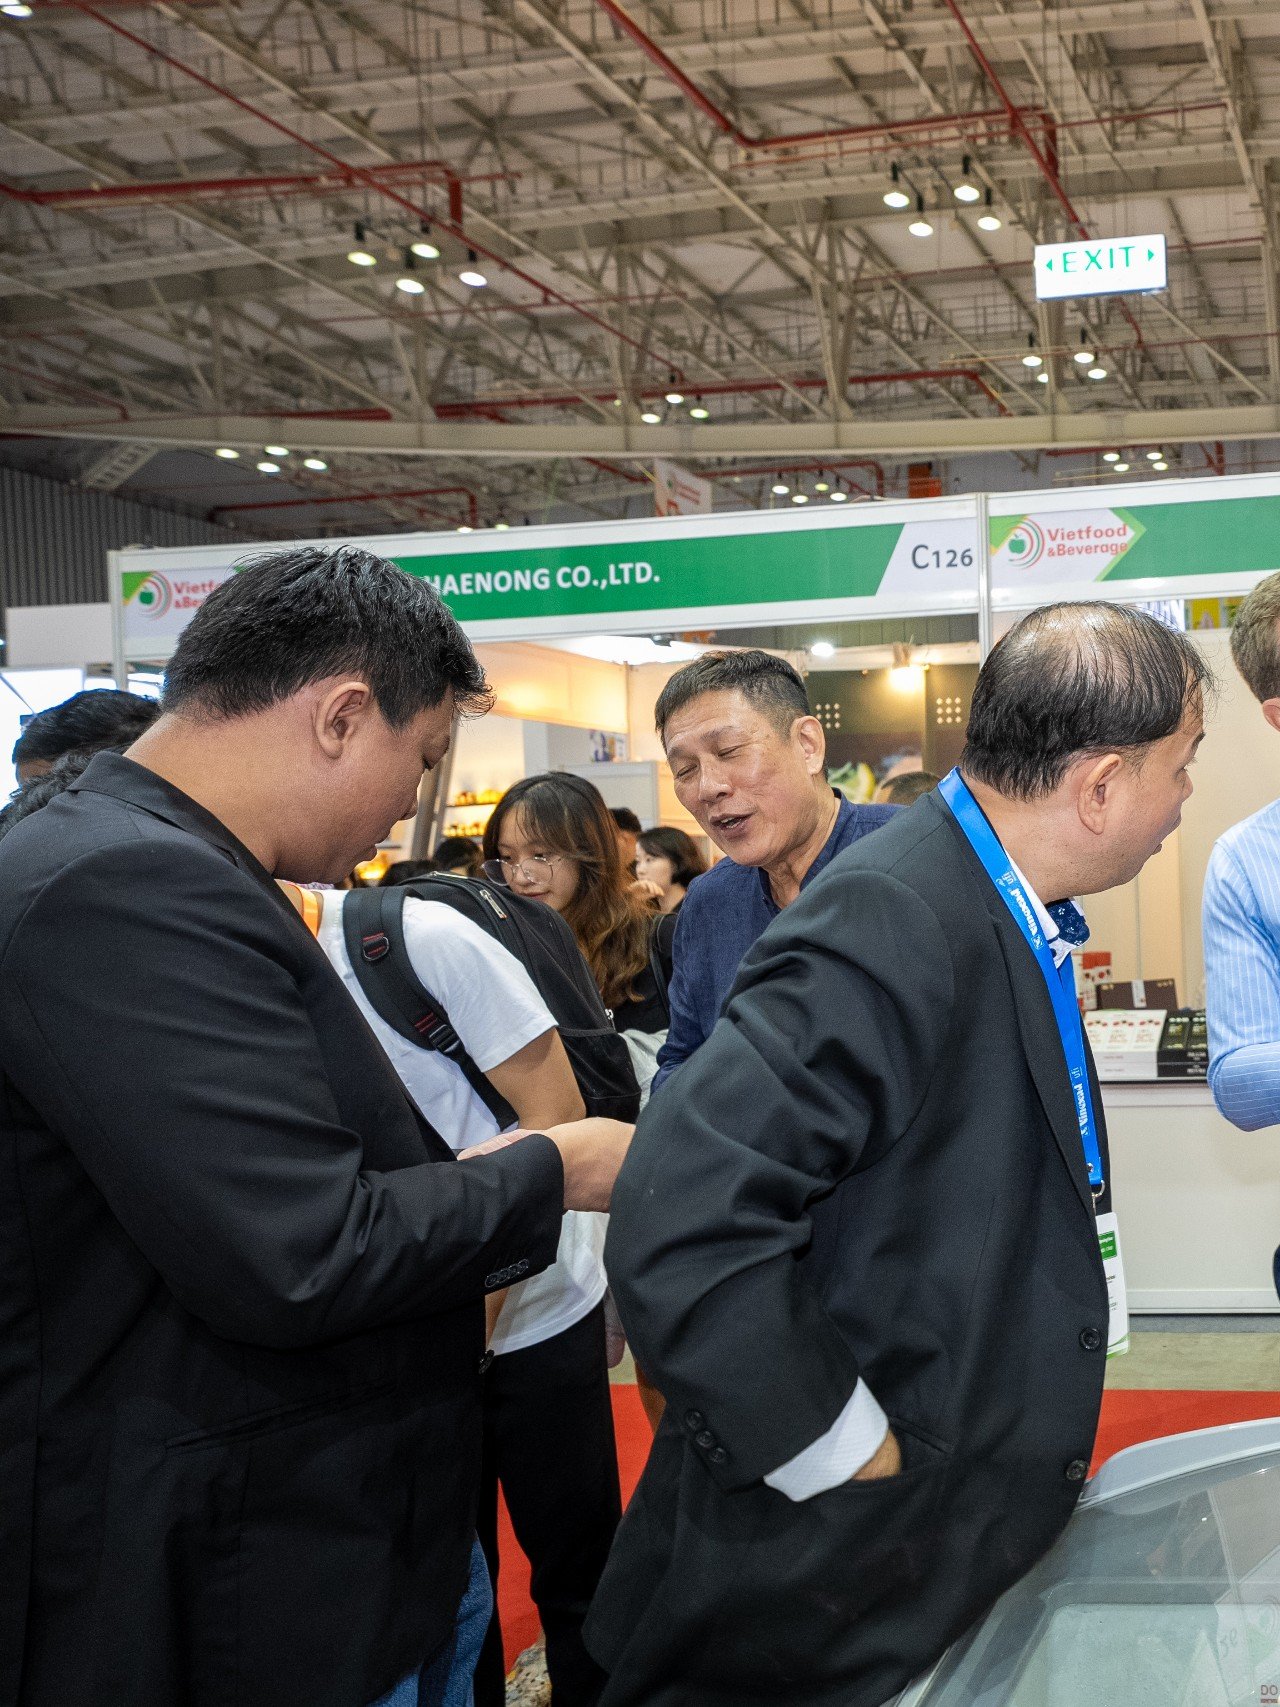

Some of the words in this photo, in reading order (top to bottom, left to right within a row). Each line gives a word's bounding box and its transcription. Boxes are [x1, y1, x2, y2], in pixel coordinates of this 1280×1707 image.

[1062, 246, 1136, 273] EXIT
[1047, 524, 1128, 542] Vietfood
[911, 544, 974, 570] C126
[1047, 541, 1128, 557] &Beverage
[555, 562, 661, 590] CO.,LTD.
[1260, 1684, 1278, 1696] DO
